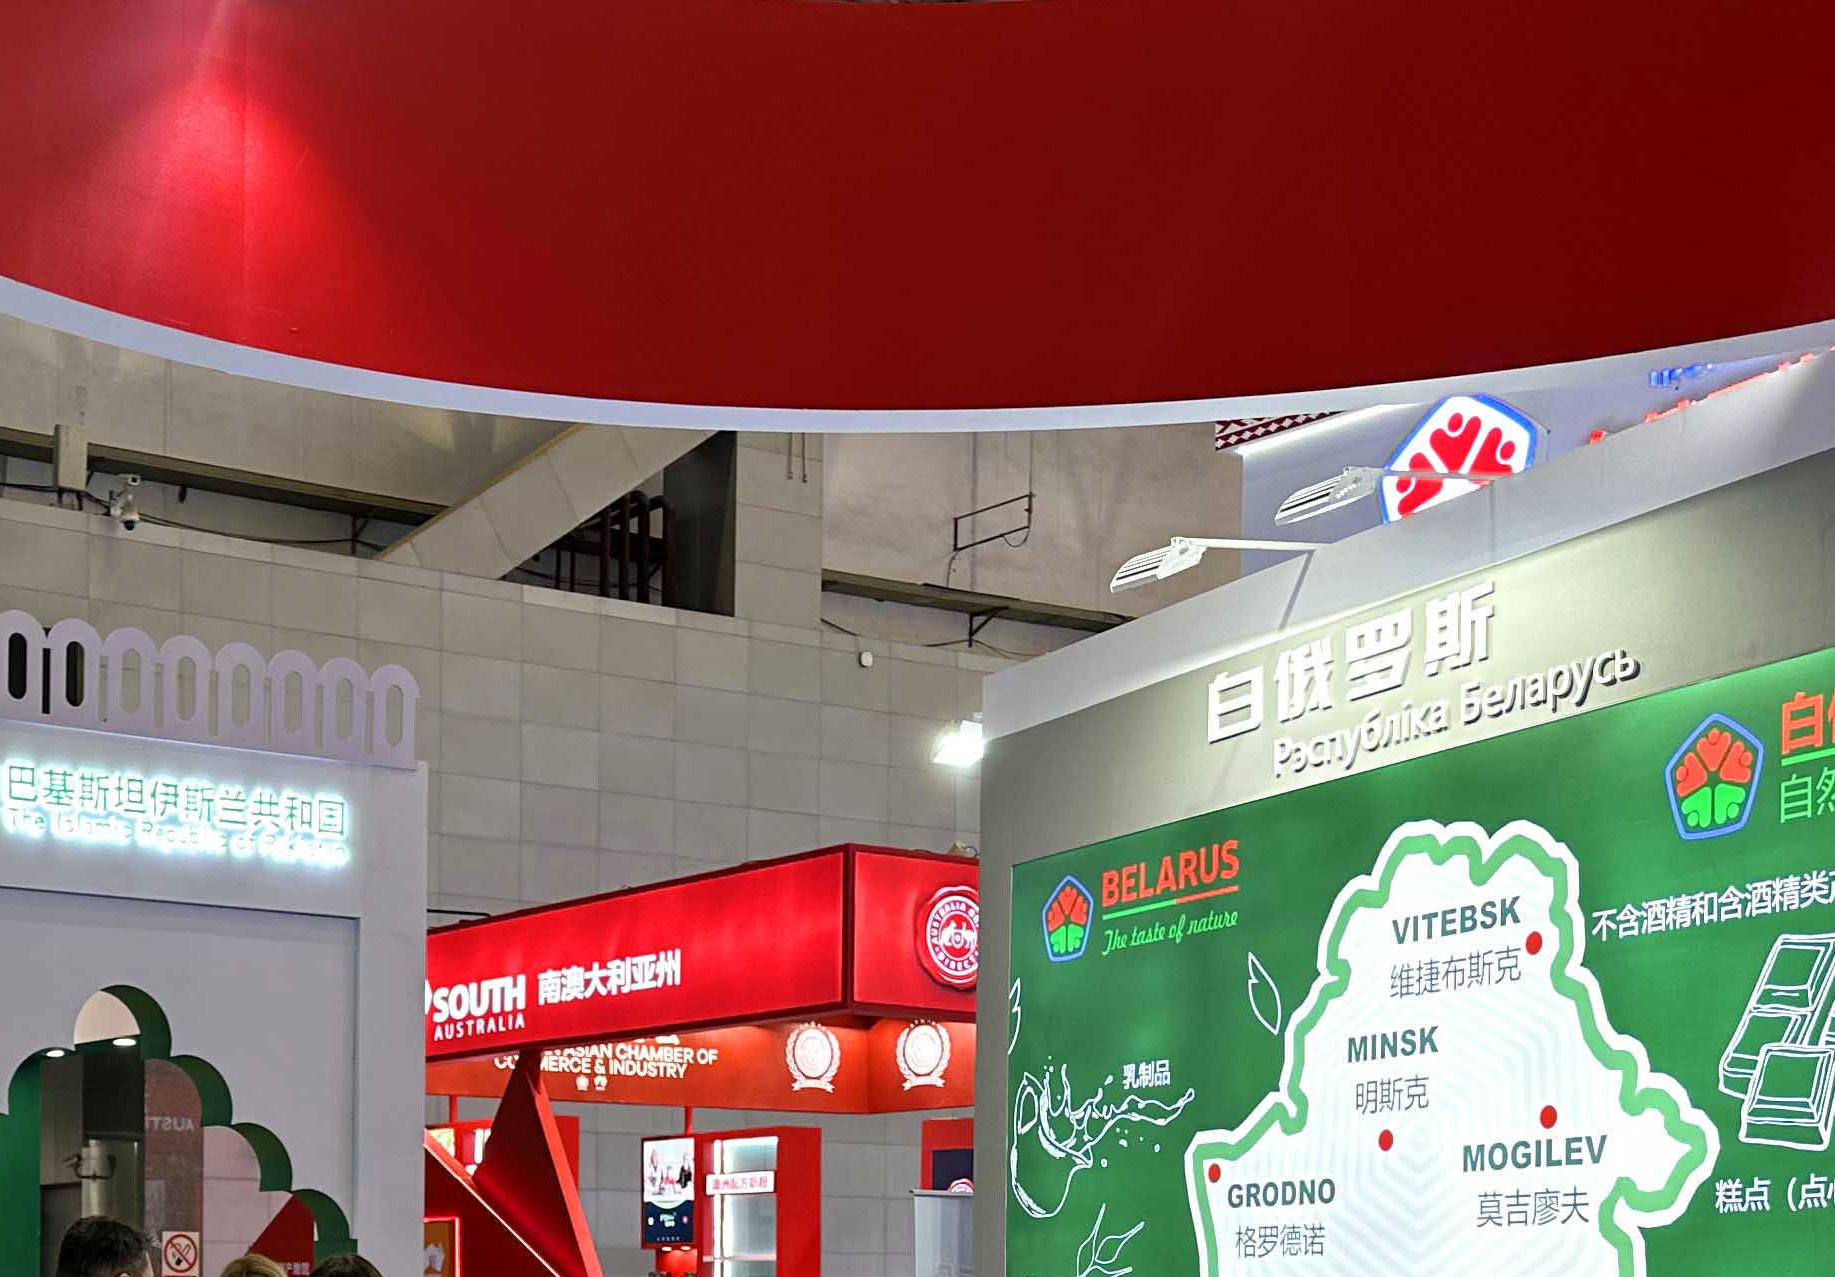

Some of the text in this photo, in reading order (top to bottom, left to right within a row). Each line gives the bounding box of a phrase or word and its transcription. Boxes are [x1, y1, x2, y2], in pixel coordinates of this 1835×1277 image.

[1207, 582, 1495, 744] 白俄罗斯
[1273, 648, 1641, 778] Рэспубліка Беларусь
[8, 765, 346, 836] 巴基斯坦伊斯兰共和国
[1101, 839, 1240, 907] BELARUS
[1392, 895, 1522, 946] VITEBSK
[1591, 868, 1835, 942] 不含酒精和含酒精类
[1102, 910, 1239, 956] The taste of nature
[538, 948, 682, 1006] 南澳大利亚州
[1390, 945, 1522, 999] 维捷布斯克
[432, 973, 527, 1024] SOUTH
[434, 1012, 526, 1041] AUSTRALIA
[1347, 1026, 1439, 1063] MINSK
[594, 1058, 688, 1079] & INDUSTRY
[615, 1043, 694, 1065] CHAMBER
[696, 1048, 719, 1065] OF
[1122, 1060, 1171, 1090] 乳制品
[1355, 1074, 1430, 1116] 明斯克
[1462, 1135, 1608, 1174] MOGILEV
[1227, 1177, 1336, 1210] GRODNO
[1234, 1224, 1326, 1259] 格罗德诺
